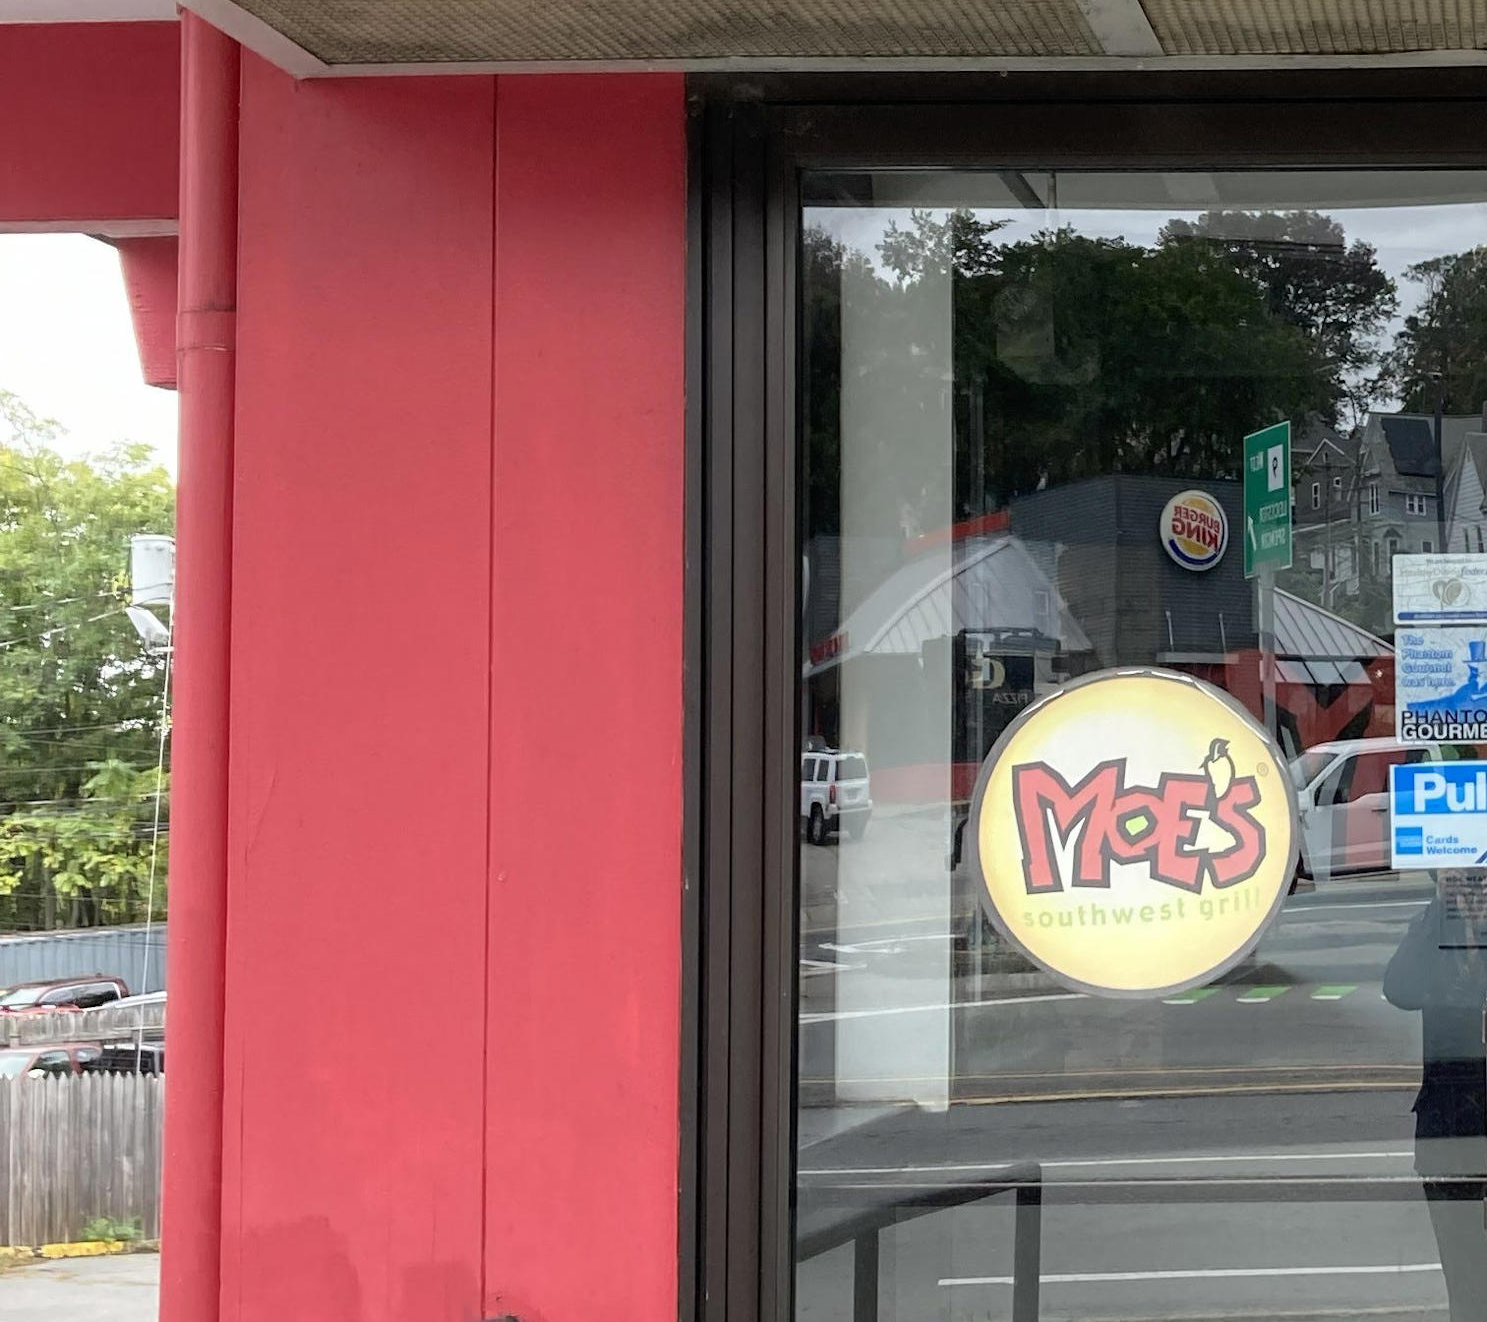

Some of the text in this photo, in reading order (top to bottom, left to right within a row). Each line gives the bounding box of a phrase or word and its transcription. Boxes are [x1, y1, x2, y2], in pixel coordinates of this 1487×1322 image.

[1426, 835, 1459, 844] Cards
[1426, 846, 1477, 855] Welcome
[1024, 886, 1261, 928] southwest grill
